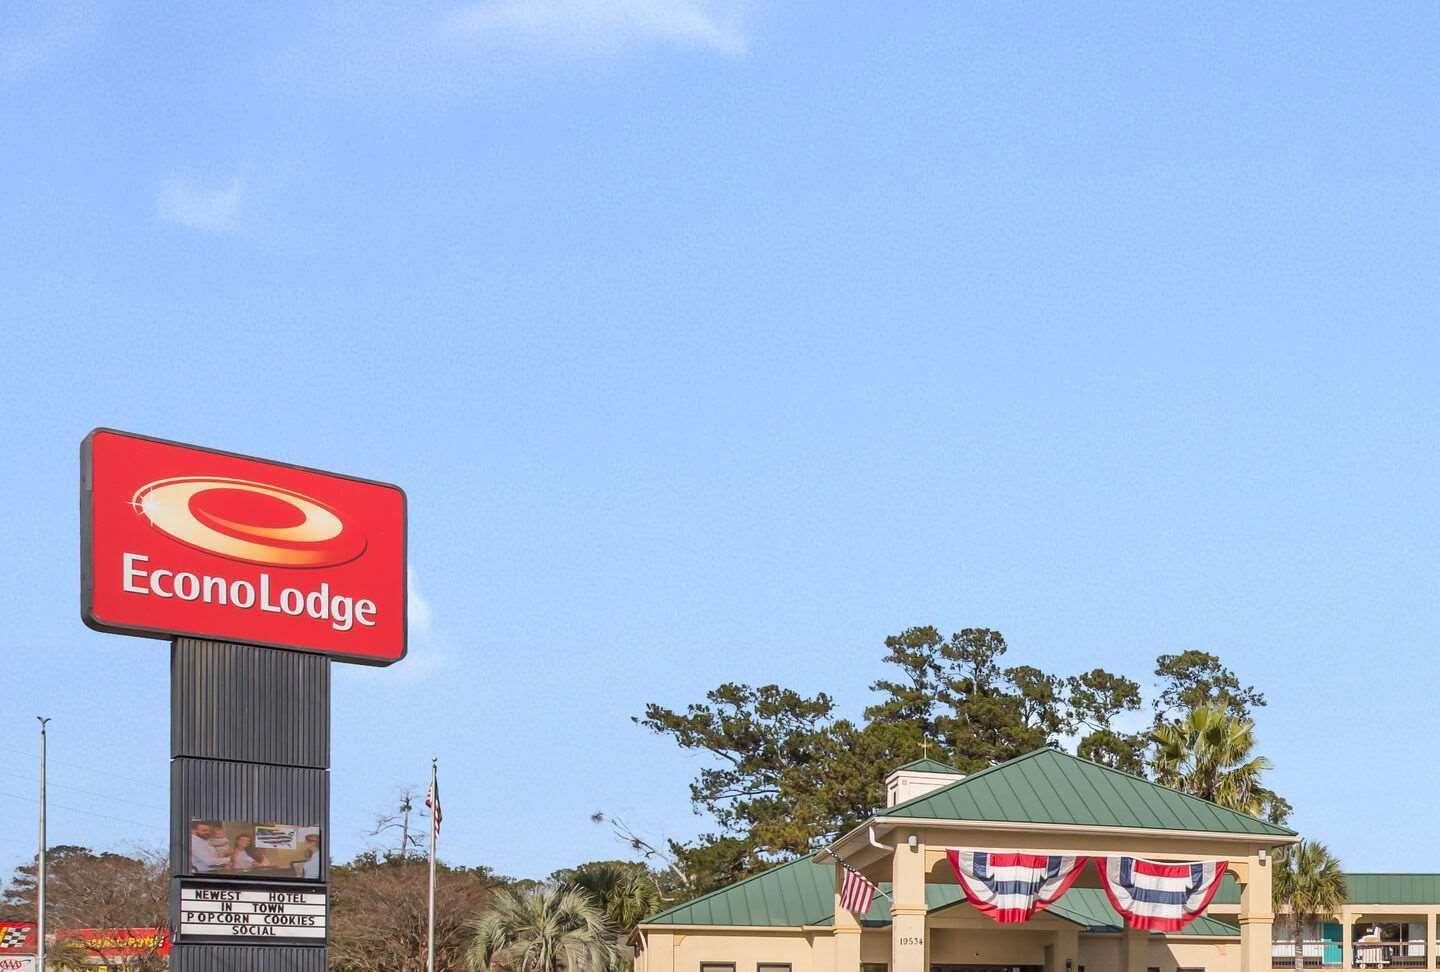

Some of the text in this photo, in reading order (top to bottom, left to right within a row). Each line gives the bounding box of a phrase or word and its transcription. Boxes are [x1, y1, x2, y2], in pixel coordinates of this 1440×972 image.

[121, 552, 377, 632] EconoLodge
[195, 890, 306, 904] NEWEST HOTEL
[221, 902, 285, 914] IN TOWN
[187, 911, 316, 926] POPCORN COOKIES
[232, 925, 277, 936] SOCIAL
